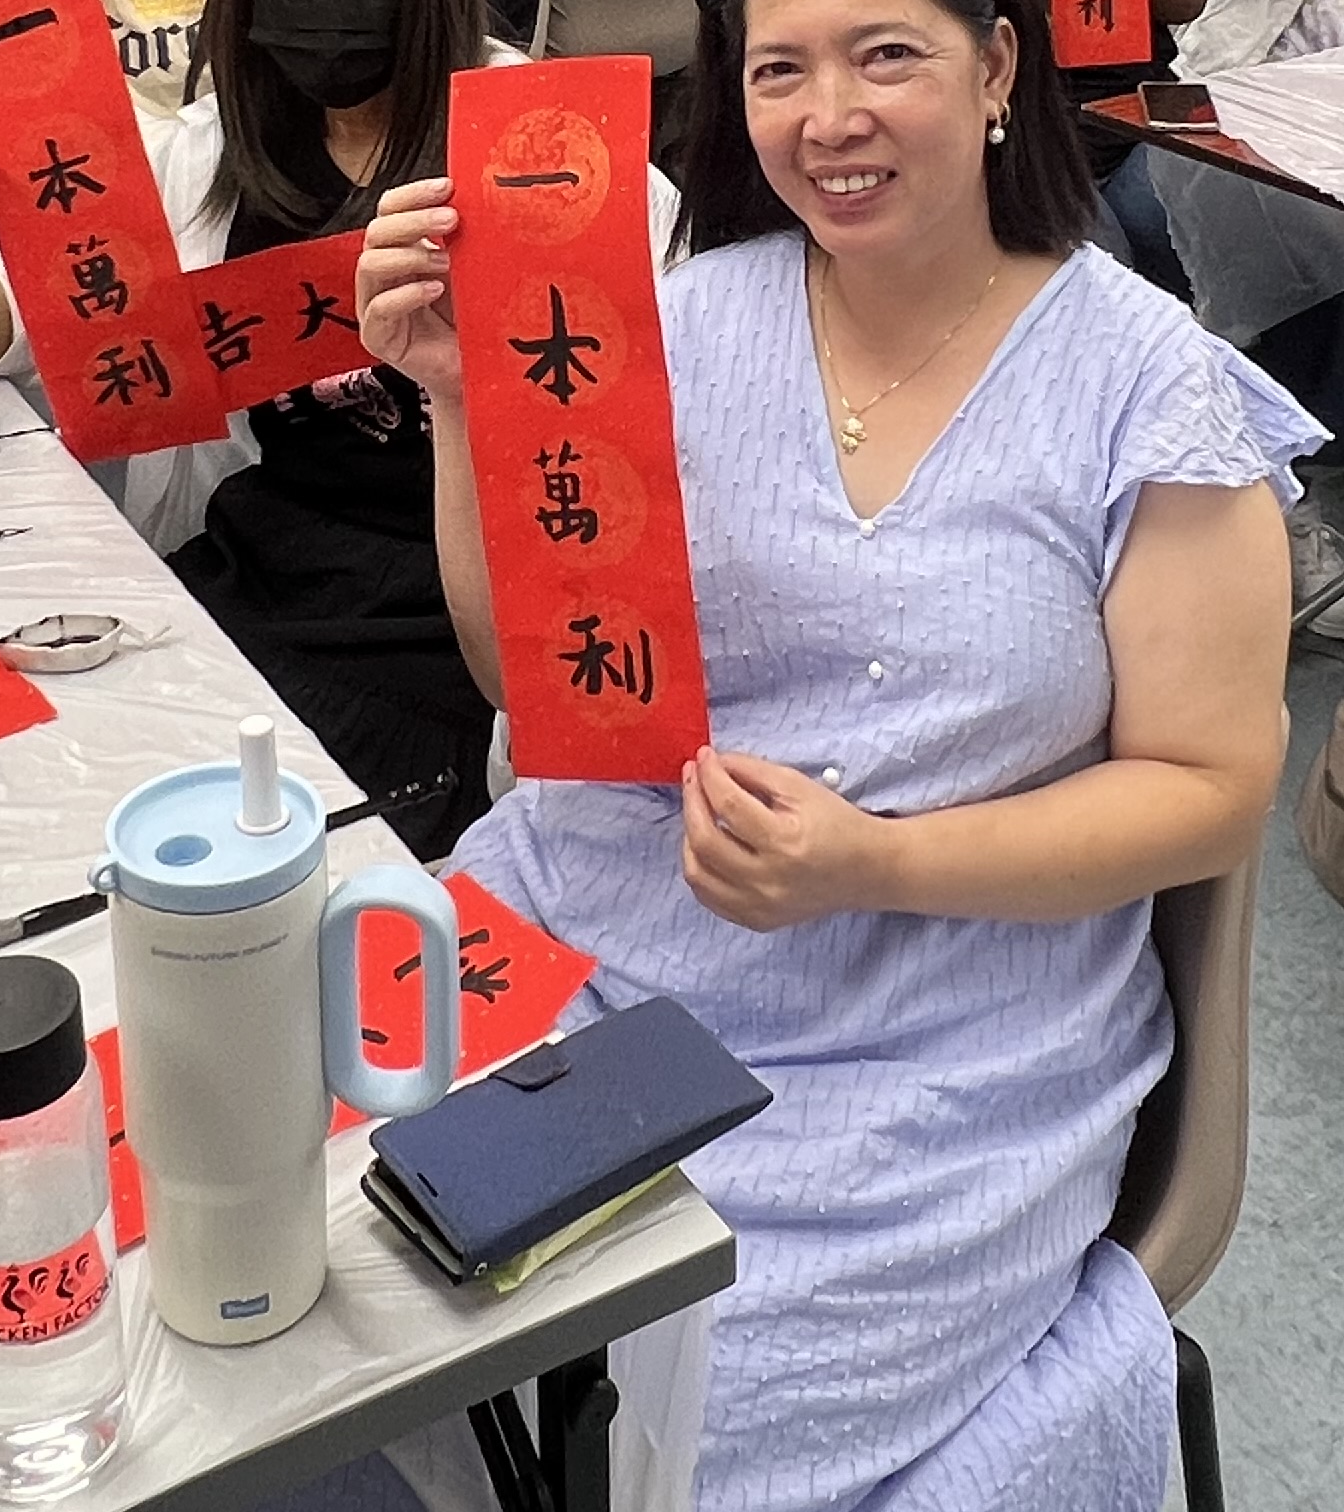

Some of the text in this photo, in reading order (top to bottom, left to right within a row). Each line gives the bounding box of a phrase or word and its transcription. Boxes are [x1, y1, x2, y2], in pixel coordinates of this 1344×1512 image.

[200, 281, 360, 372] 吉大
[492, 170, 655, 705] 一本萬利
